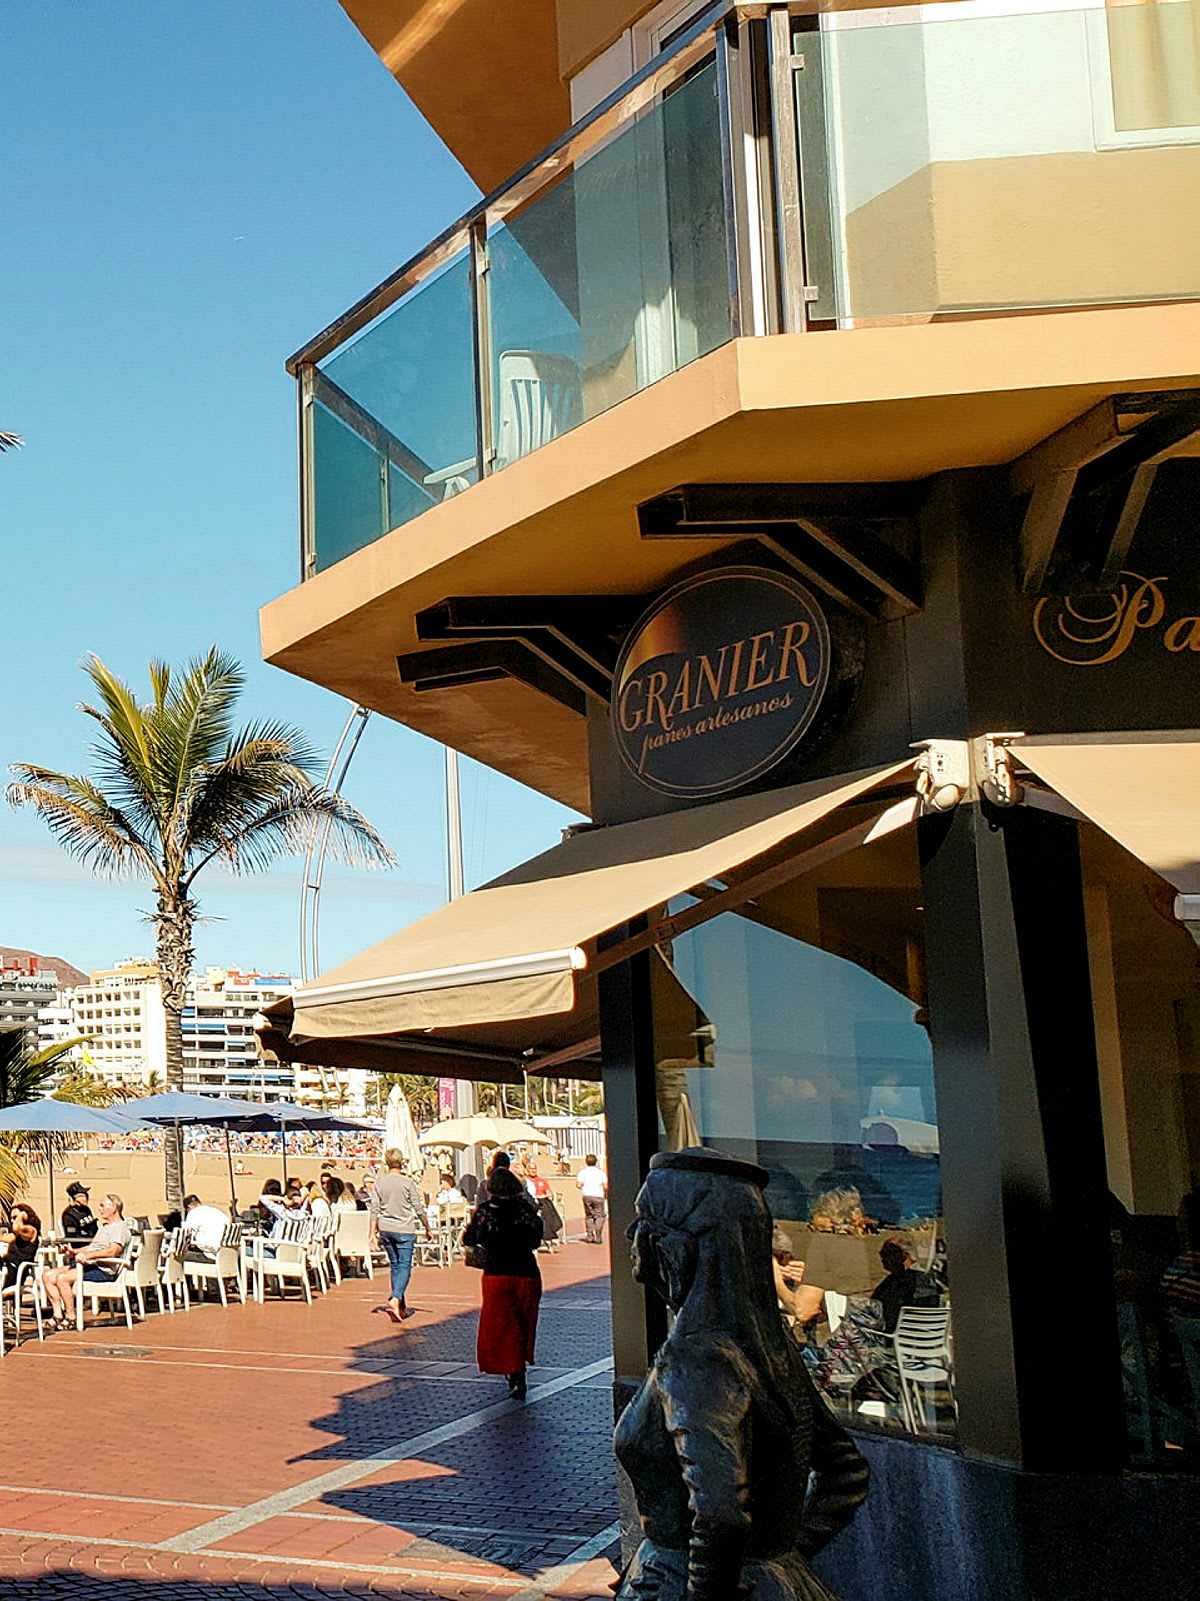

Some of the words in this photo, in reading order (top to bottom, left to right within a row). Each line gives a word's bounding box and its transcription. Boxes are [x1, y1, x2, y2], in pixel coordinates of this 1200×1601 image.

[619, 621, 817, 732] GRANIER
[638, 726, 692, 774] panes
[695, 692, 794, 735] artesanos
